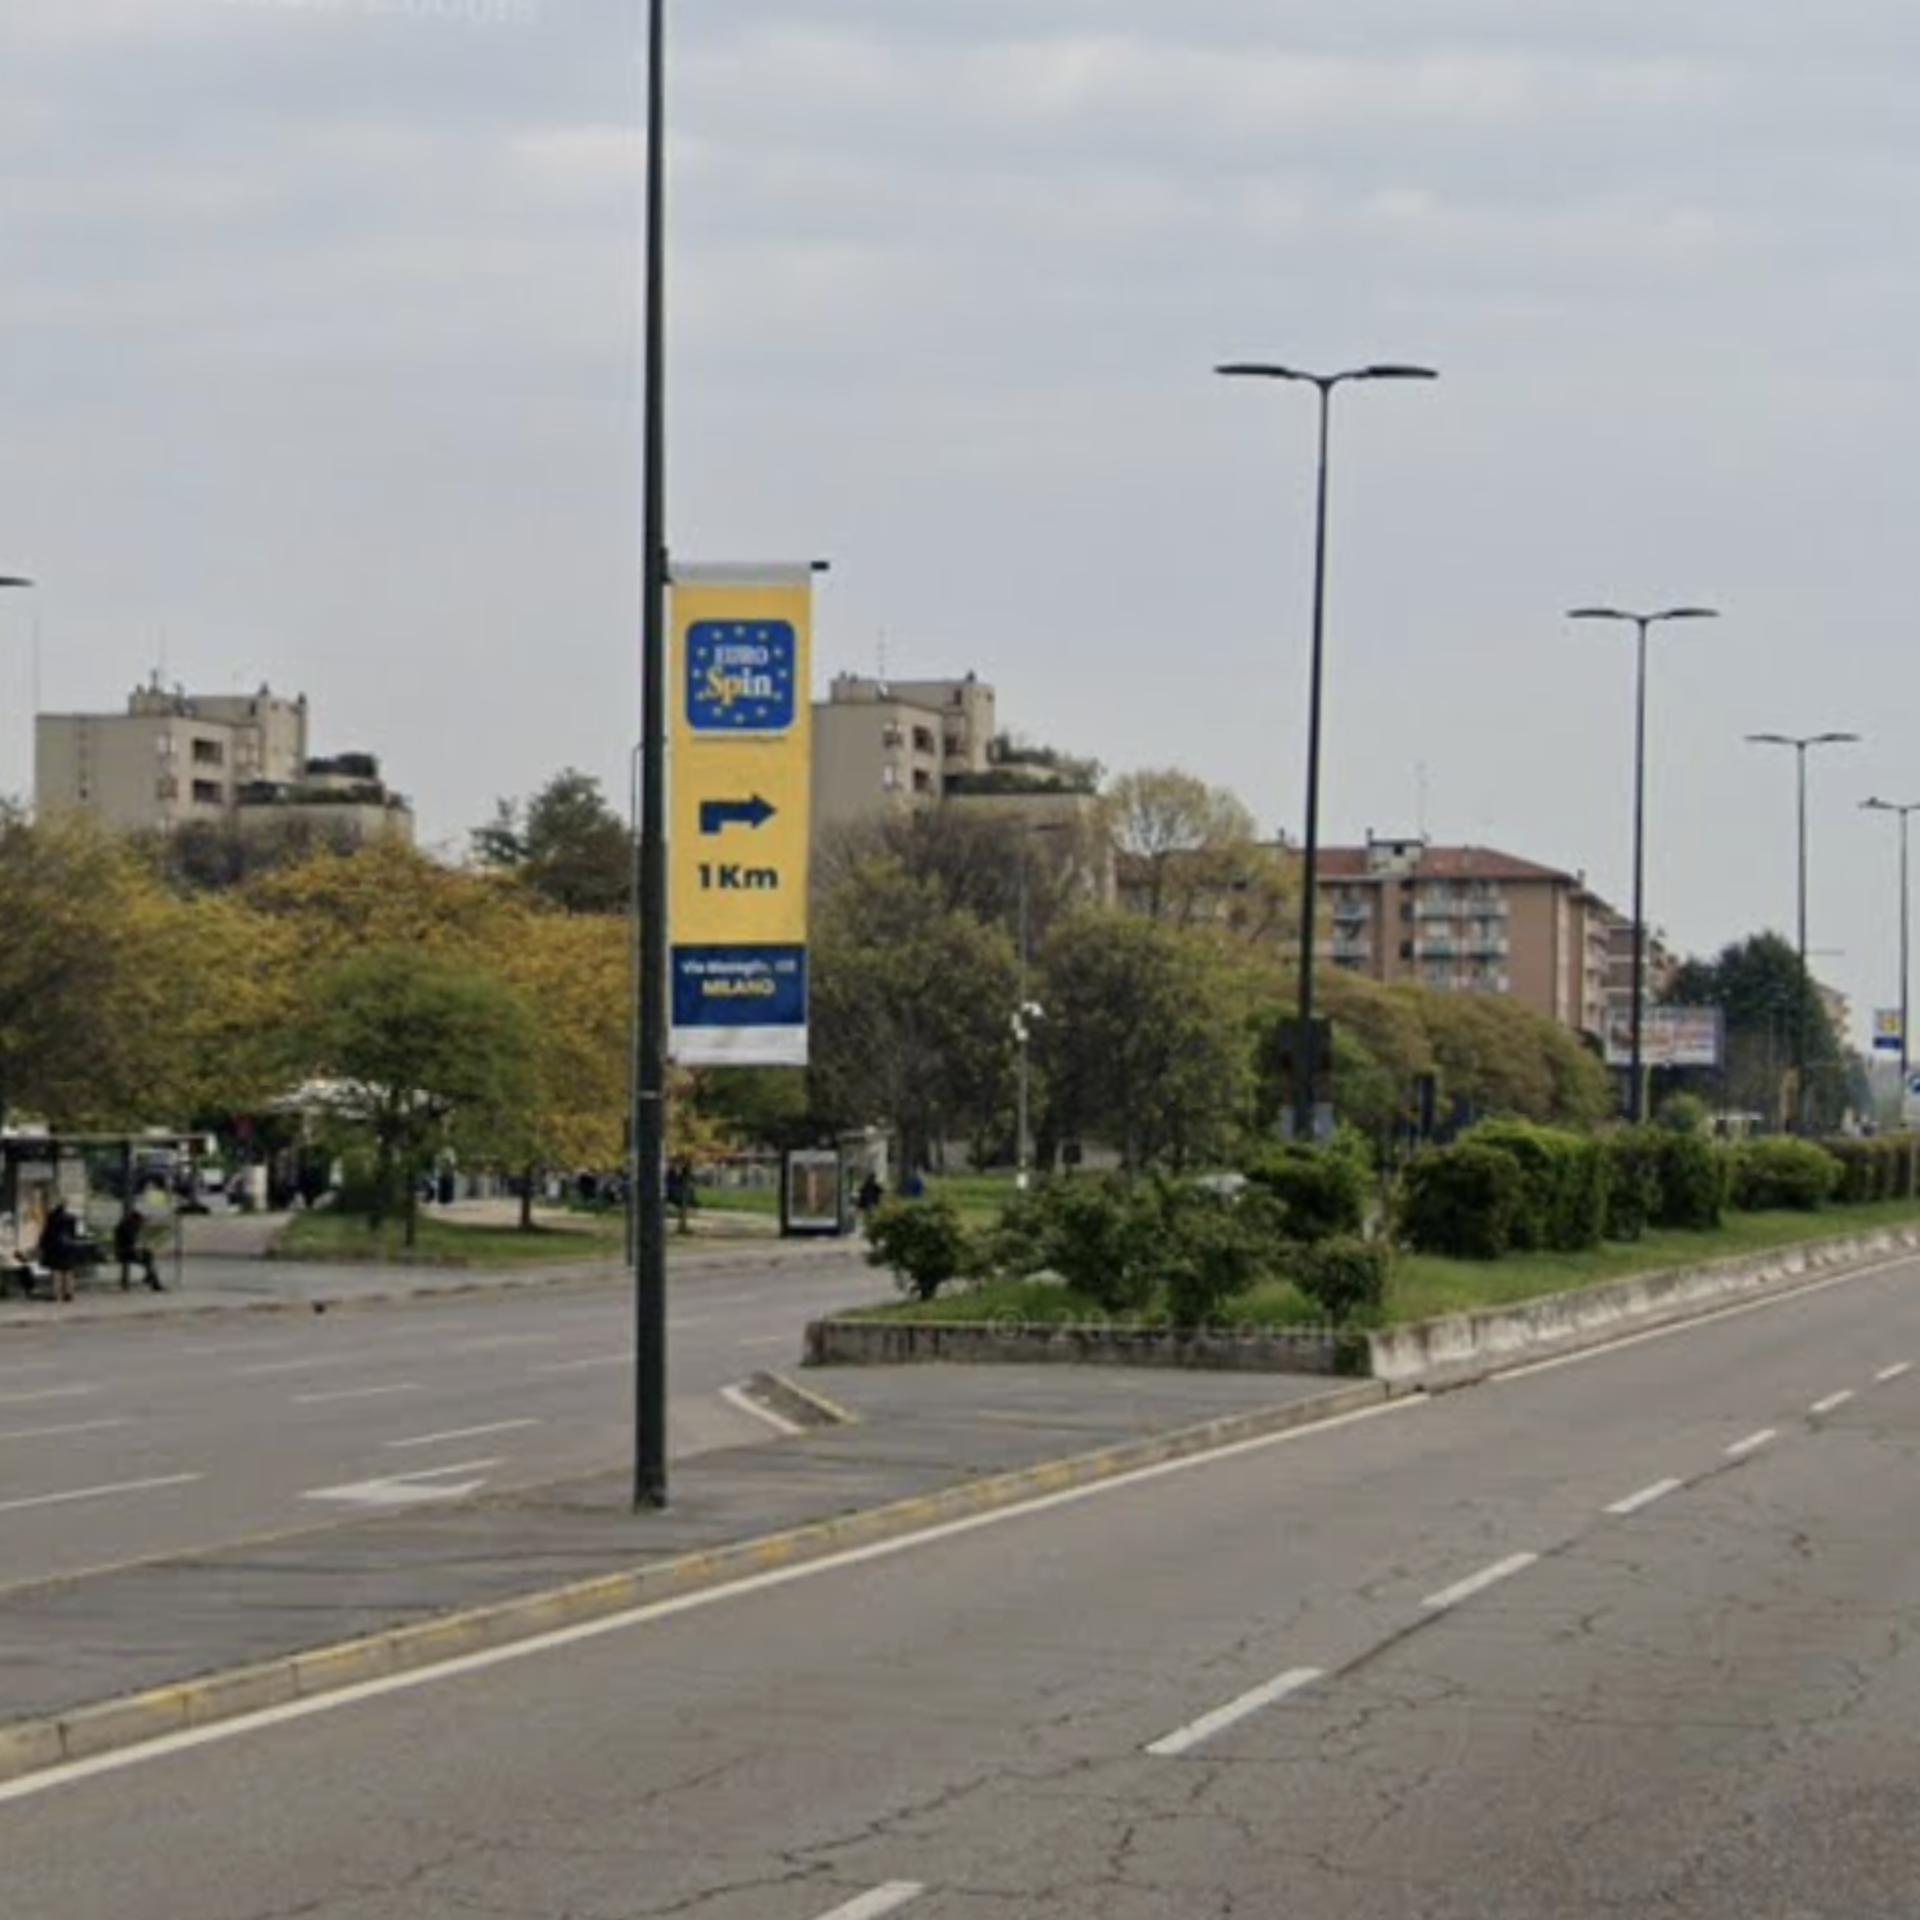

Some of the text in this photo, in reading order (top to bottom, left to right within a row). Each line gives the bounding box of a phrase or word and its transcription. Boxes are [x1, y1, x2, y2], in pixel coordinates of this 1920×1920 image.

[714, 645, 769, 666] EURO
[705, 665, 773, 705] Spin
[698, 863, 778, 890] 1 Km
[702, 979, 776, 996] MILANO
